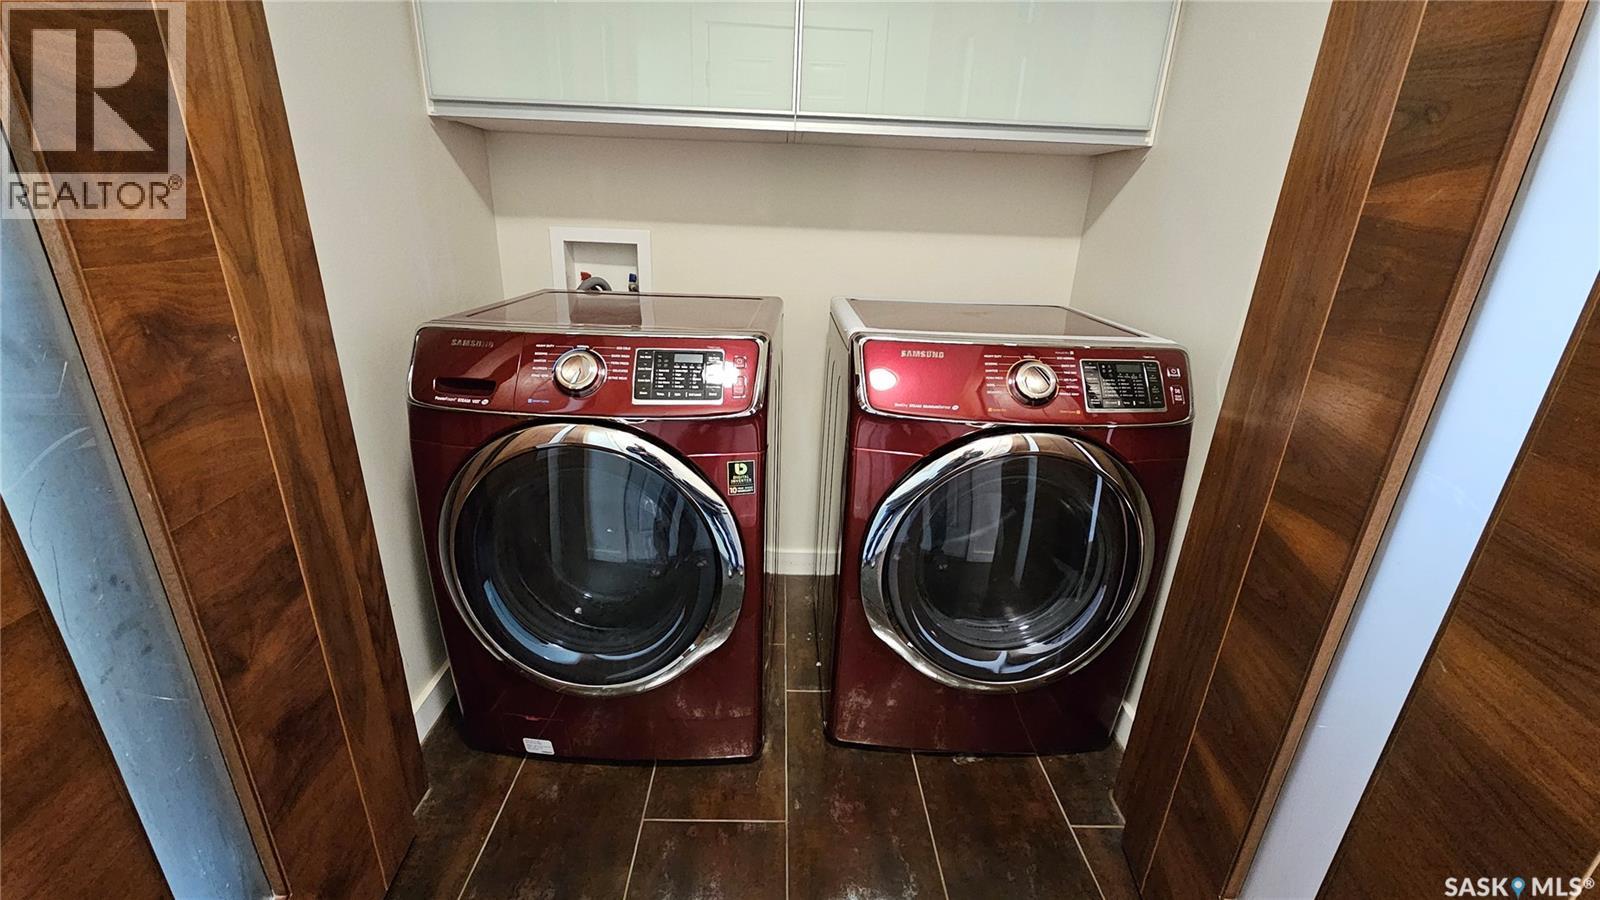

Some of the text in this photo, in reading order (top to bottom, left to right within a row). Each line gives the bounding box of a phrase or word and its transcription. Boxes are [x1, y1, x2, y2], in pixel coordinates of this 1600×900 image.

[450, 338, 495, 349] SAMSUNG
[900, 349, 945, 359] SAMSUNG
[729, 486, 738, 494] 10
